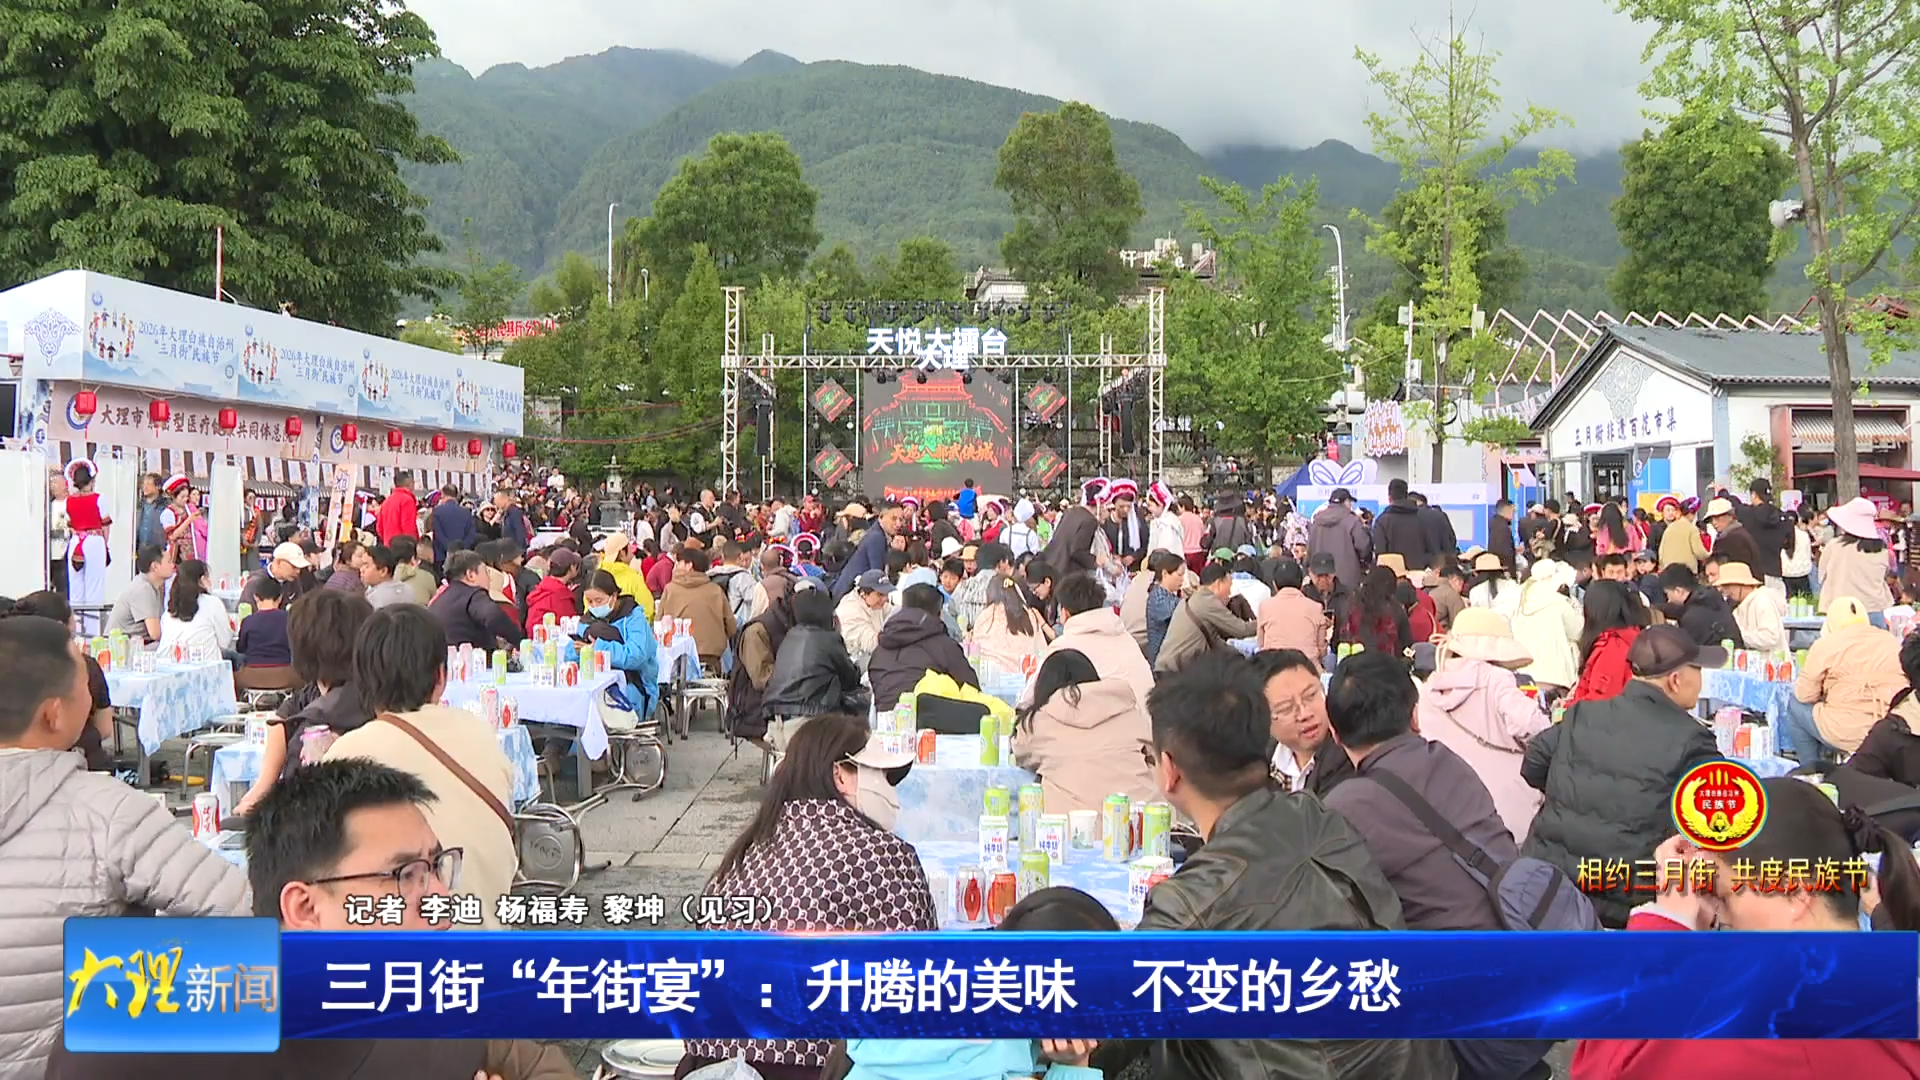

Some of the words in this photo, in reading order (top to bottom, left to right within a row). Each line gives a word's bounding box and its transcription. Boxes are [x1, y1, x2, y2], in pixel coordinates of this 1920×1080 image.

[138, 321, 234, 354] 2026年大理白族自治州
[867, 327, 1008, 355] 天悦大擂台
